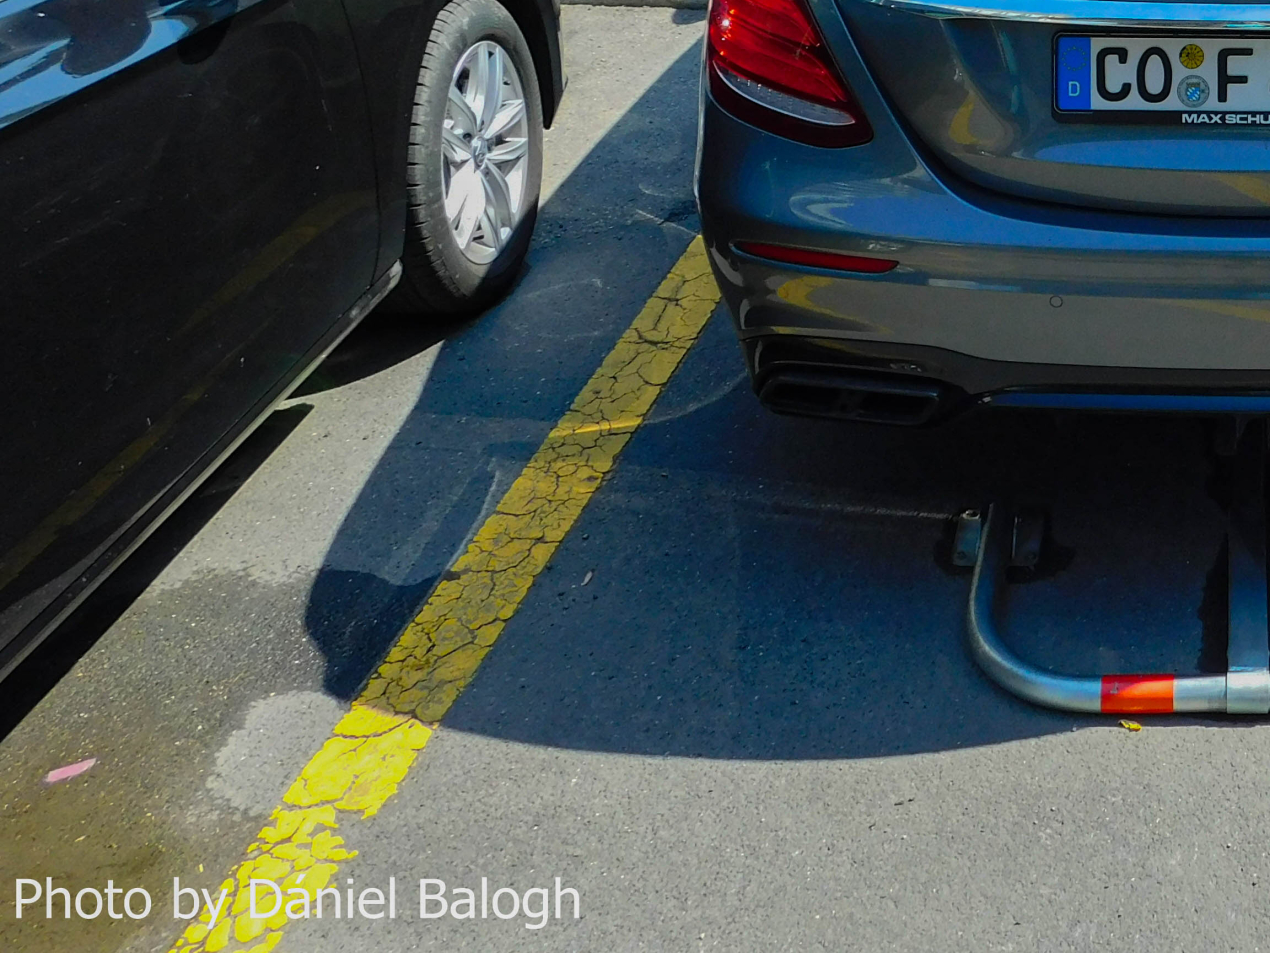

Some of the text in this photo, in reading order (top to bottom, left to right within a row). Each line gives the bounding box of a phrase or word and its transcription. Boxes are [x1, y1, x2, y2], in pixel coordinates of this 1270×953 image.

[1096, 46, 1173, 103] CO
[1217, 48, 1254, 103] F
[1068, 81, 1080, 97] D
[1181, 113, 1222, 125] MAX
